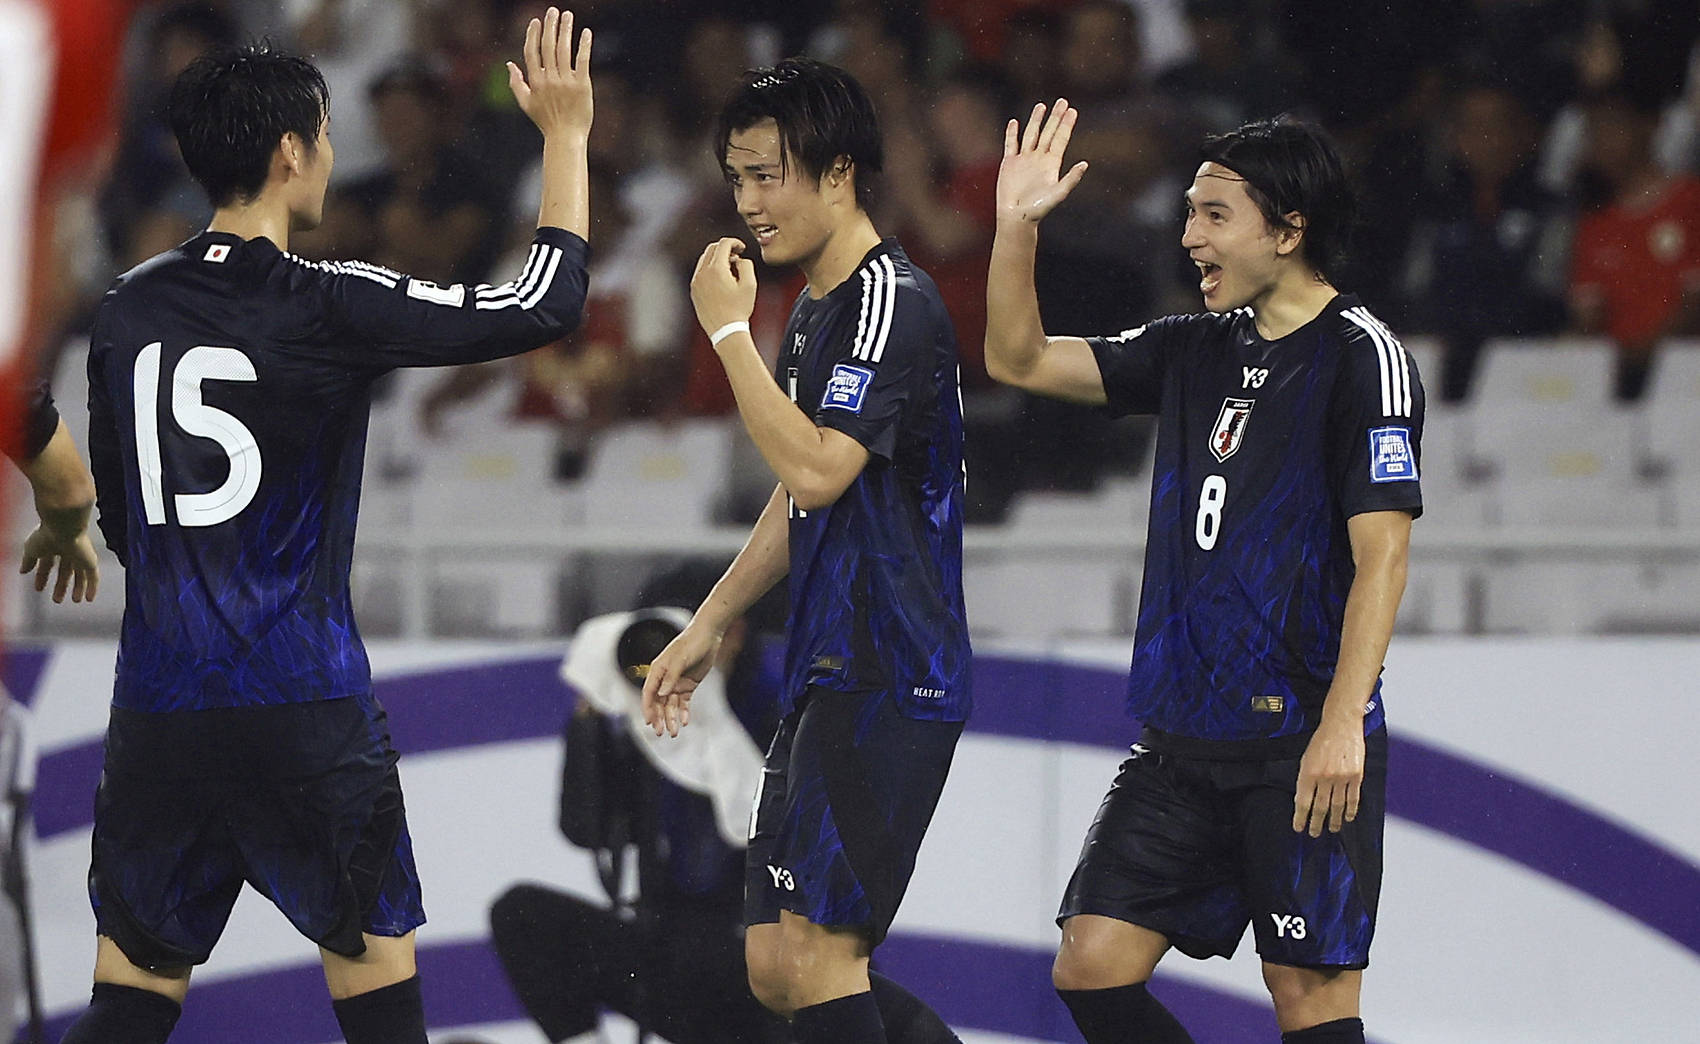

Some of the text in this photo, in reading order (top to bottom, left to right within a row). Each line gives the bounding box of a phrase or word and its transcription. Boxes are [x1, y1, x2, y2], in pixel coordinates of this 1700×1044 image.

[1242, 366, 1269, 389] Y-3
[133, 341, 262, 527] 15
[1195, 474, 1227, 551] 8
[766, 864, 796, 892] Y-3
[1270, 913, 1307, 940] Y-3
